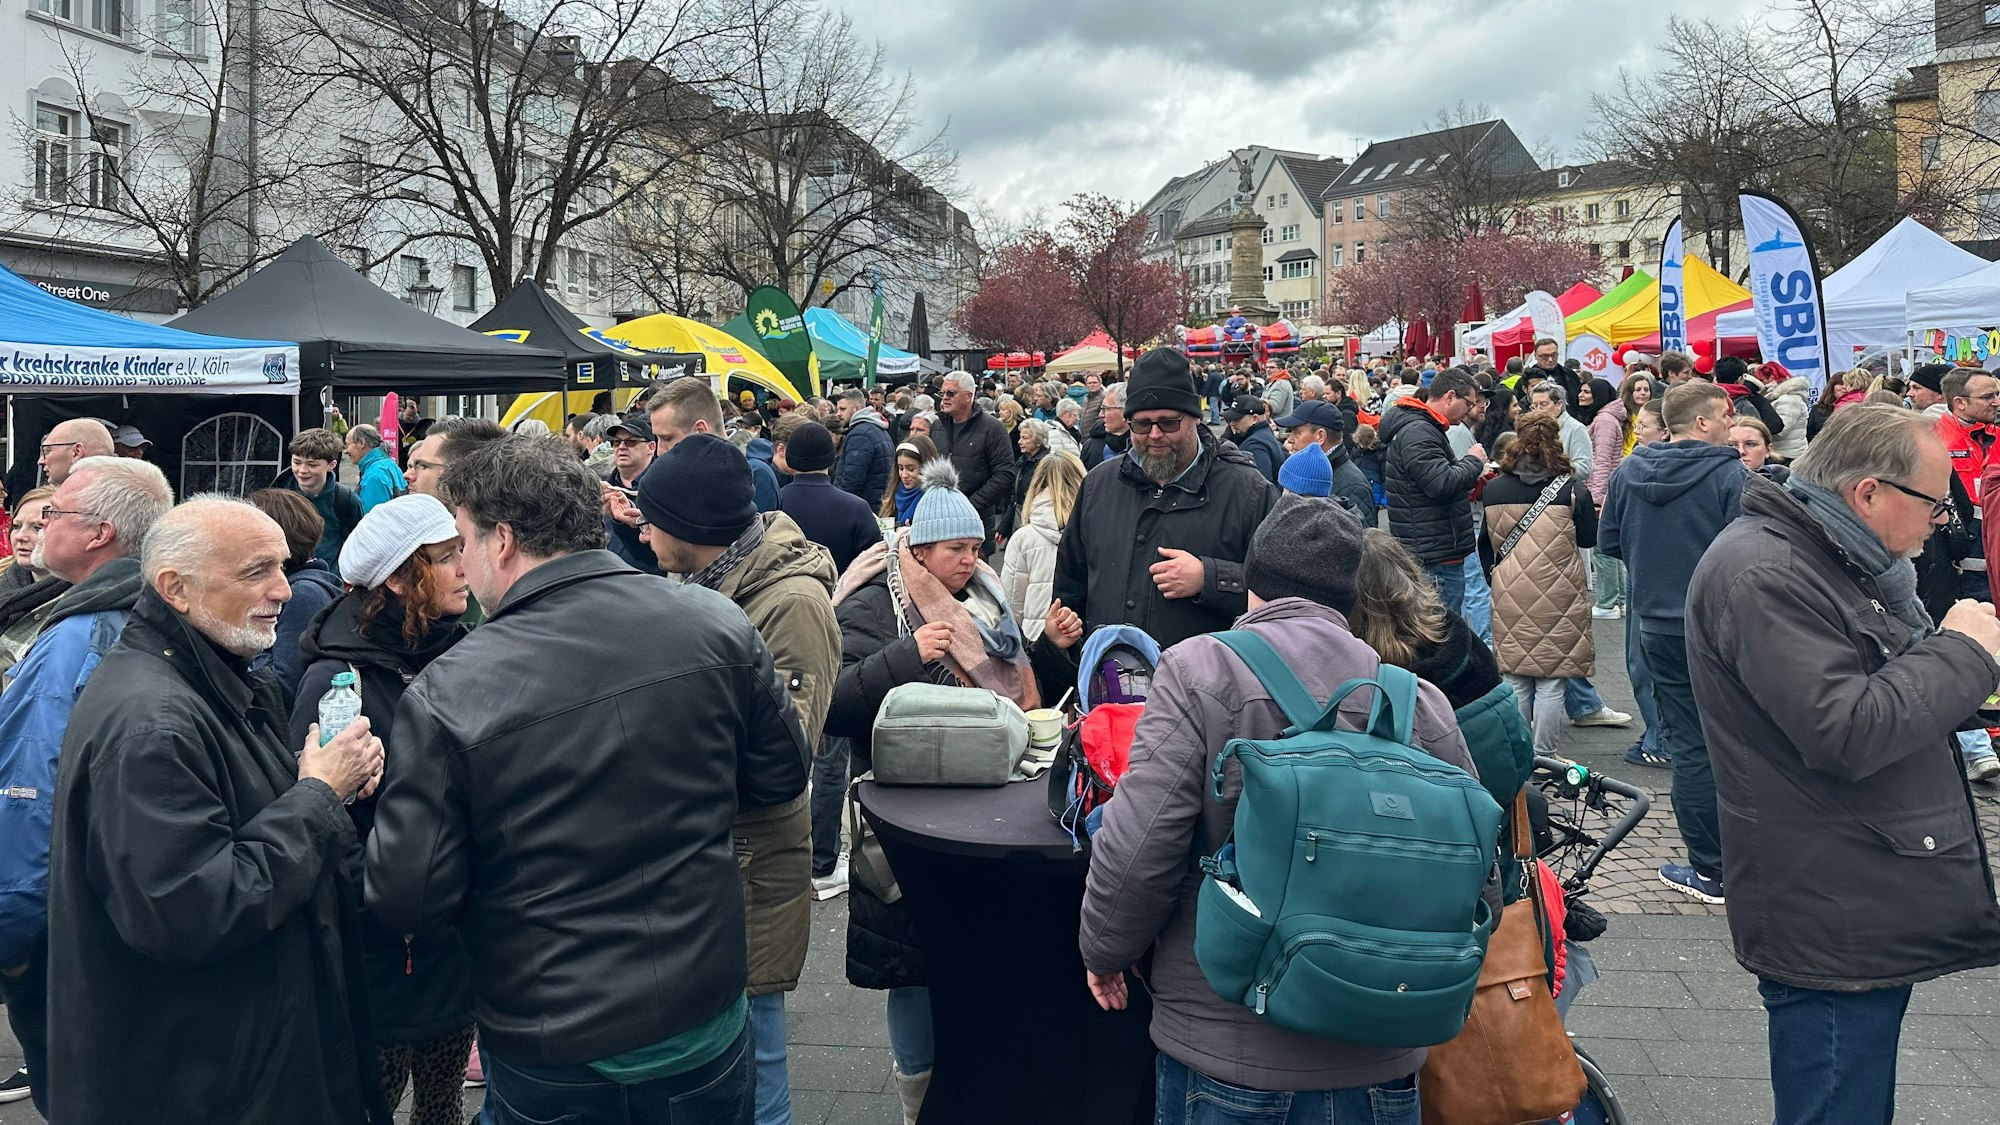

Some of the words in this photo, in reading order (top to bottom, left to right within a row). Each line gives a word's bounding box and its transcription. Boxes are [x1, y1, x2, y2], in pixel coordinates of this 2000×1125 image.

[37, 282, 81, 300] Street
[82, 286, 110, 302] One
[1771, 270, 1820, 370] SBU
[1924, 327, 1973, 362] TEAM
[13, 351, 119, 375] krebskranke
[123, 355, 174, 376] Kinder
[175, 357, 198, 376] e.V.
[202, 356, 230, 376] Köln
